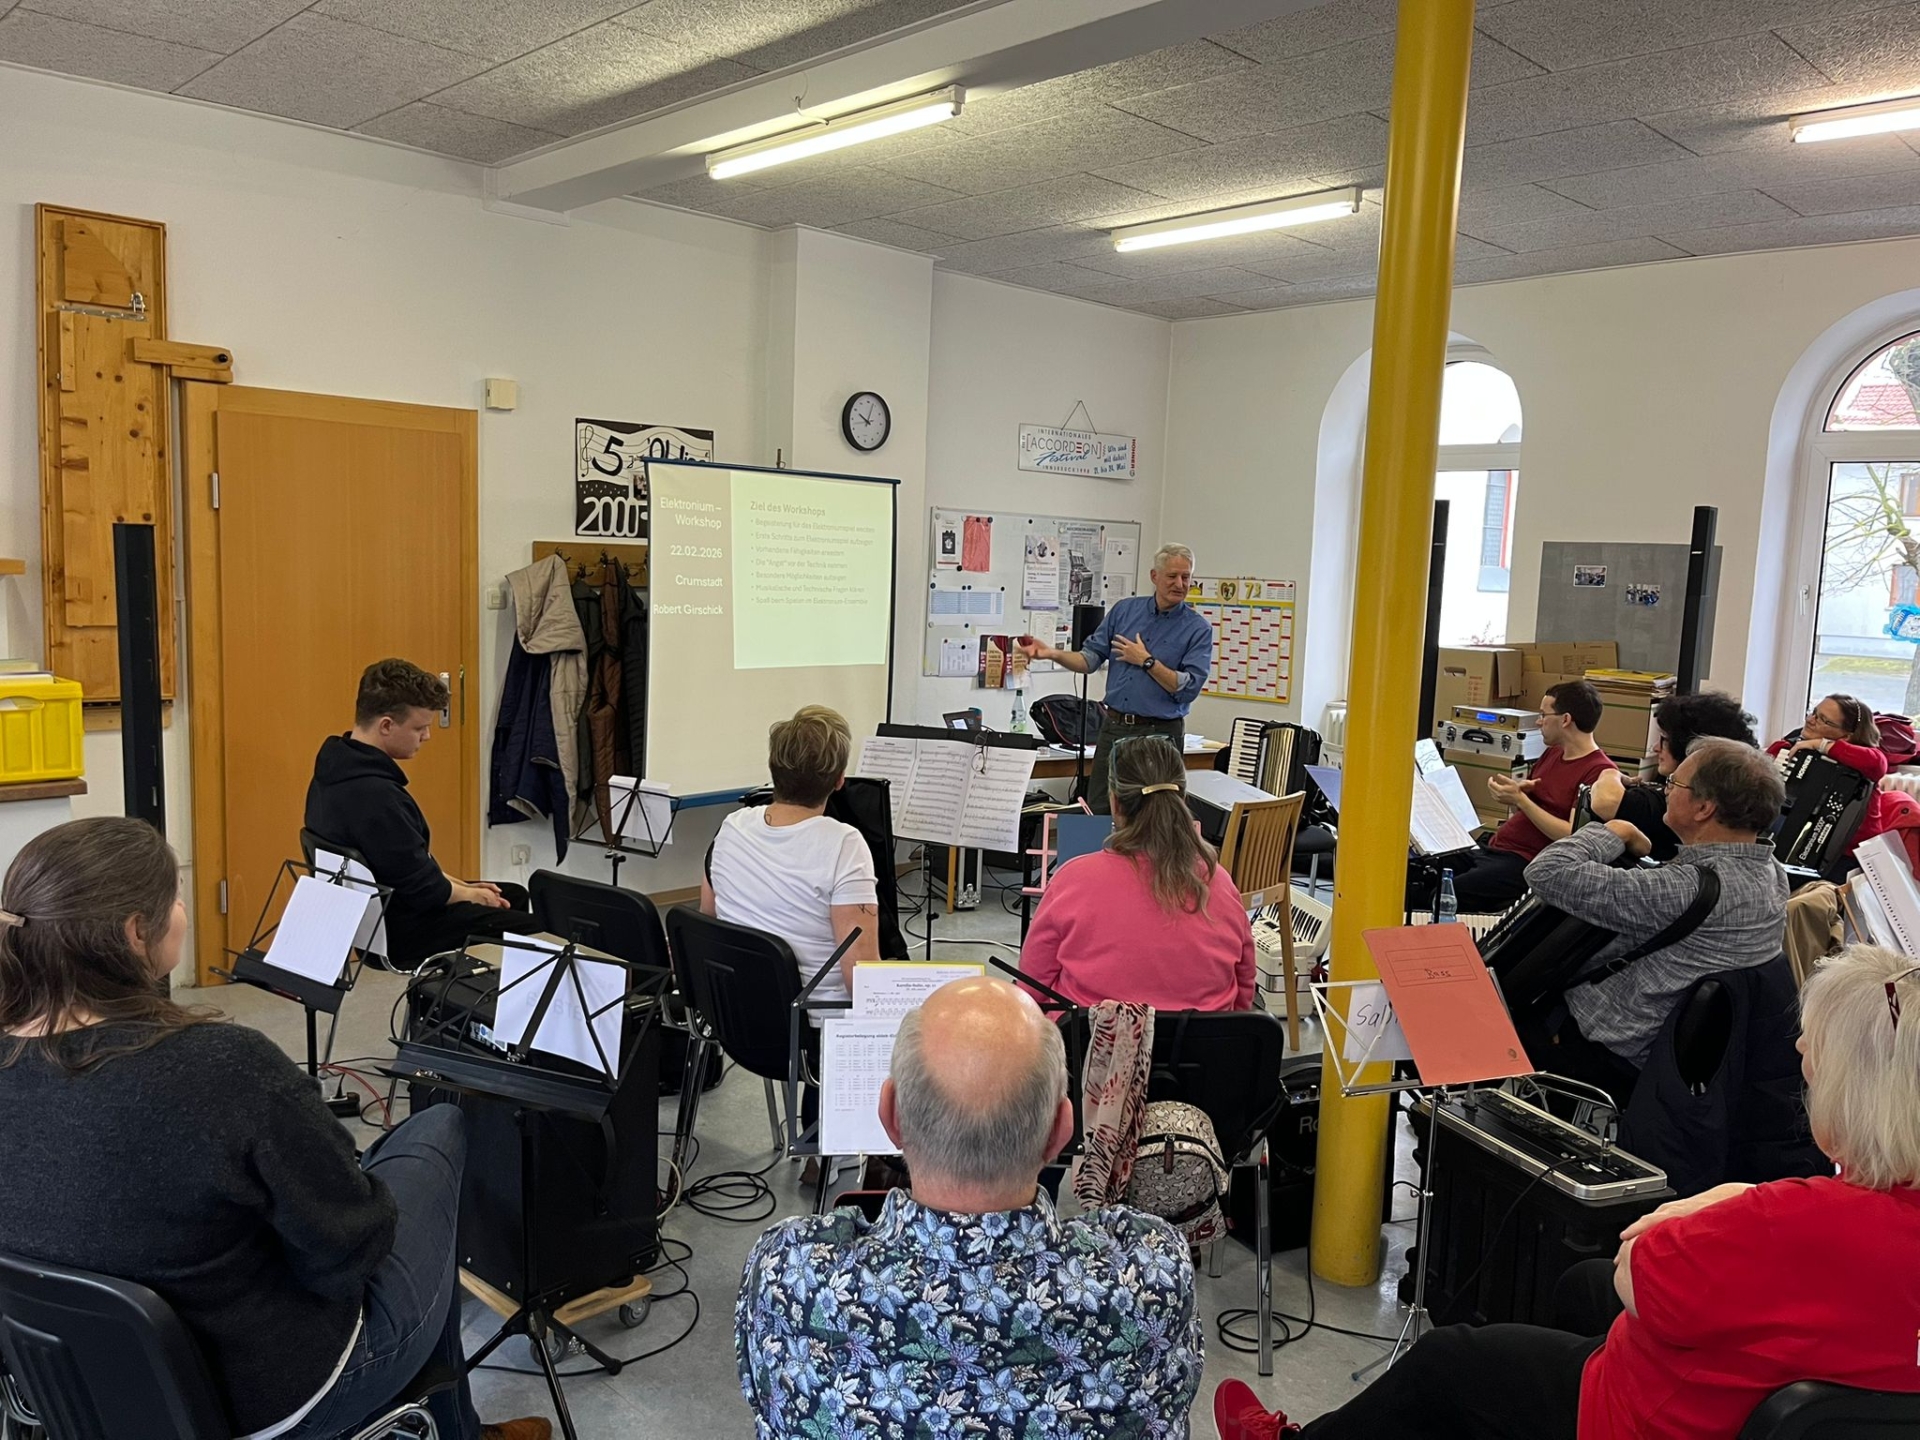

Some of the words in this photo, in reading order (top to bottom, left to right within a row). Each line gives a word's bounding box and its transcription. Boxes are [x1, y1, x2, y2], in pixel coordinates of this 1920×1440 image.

[1037, 428, 1092, 440] INTERNATIONALES
[1033, 450, 1090, 466] Festival
[660, 497, 715, 512] Elektronium
[750, 501, 766, 511] Ziel
[767, 502, 781, 512] des
[783, 504, 826, 517] Workshops
[675, 513, 721, 530] Workshop
[670, 545, 723, 559] 22.02.2026
[675, 574, 723, 588] Crumstadt
[653, 603, 682, 615] Robert
[683, 603, 723, 615] Girschick
[1796, 754, 1814, 779] HOHNER
[1424, 968, 1451, 980] Bass
